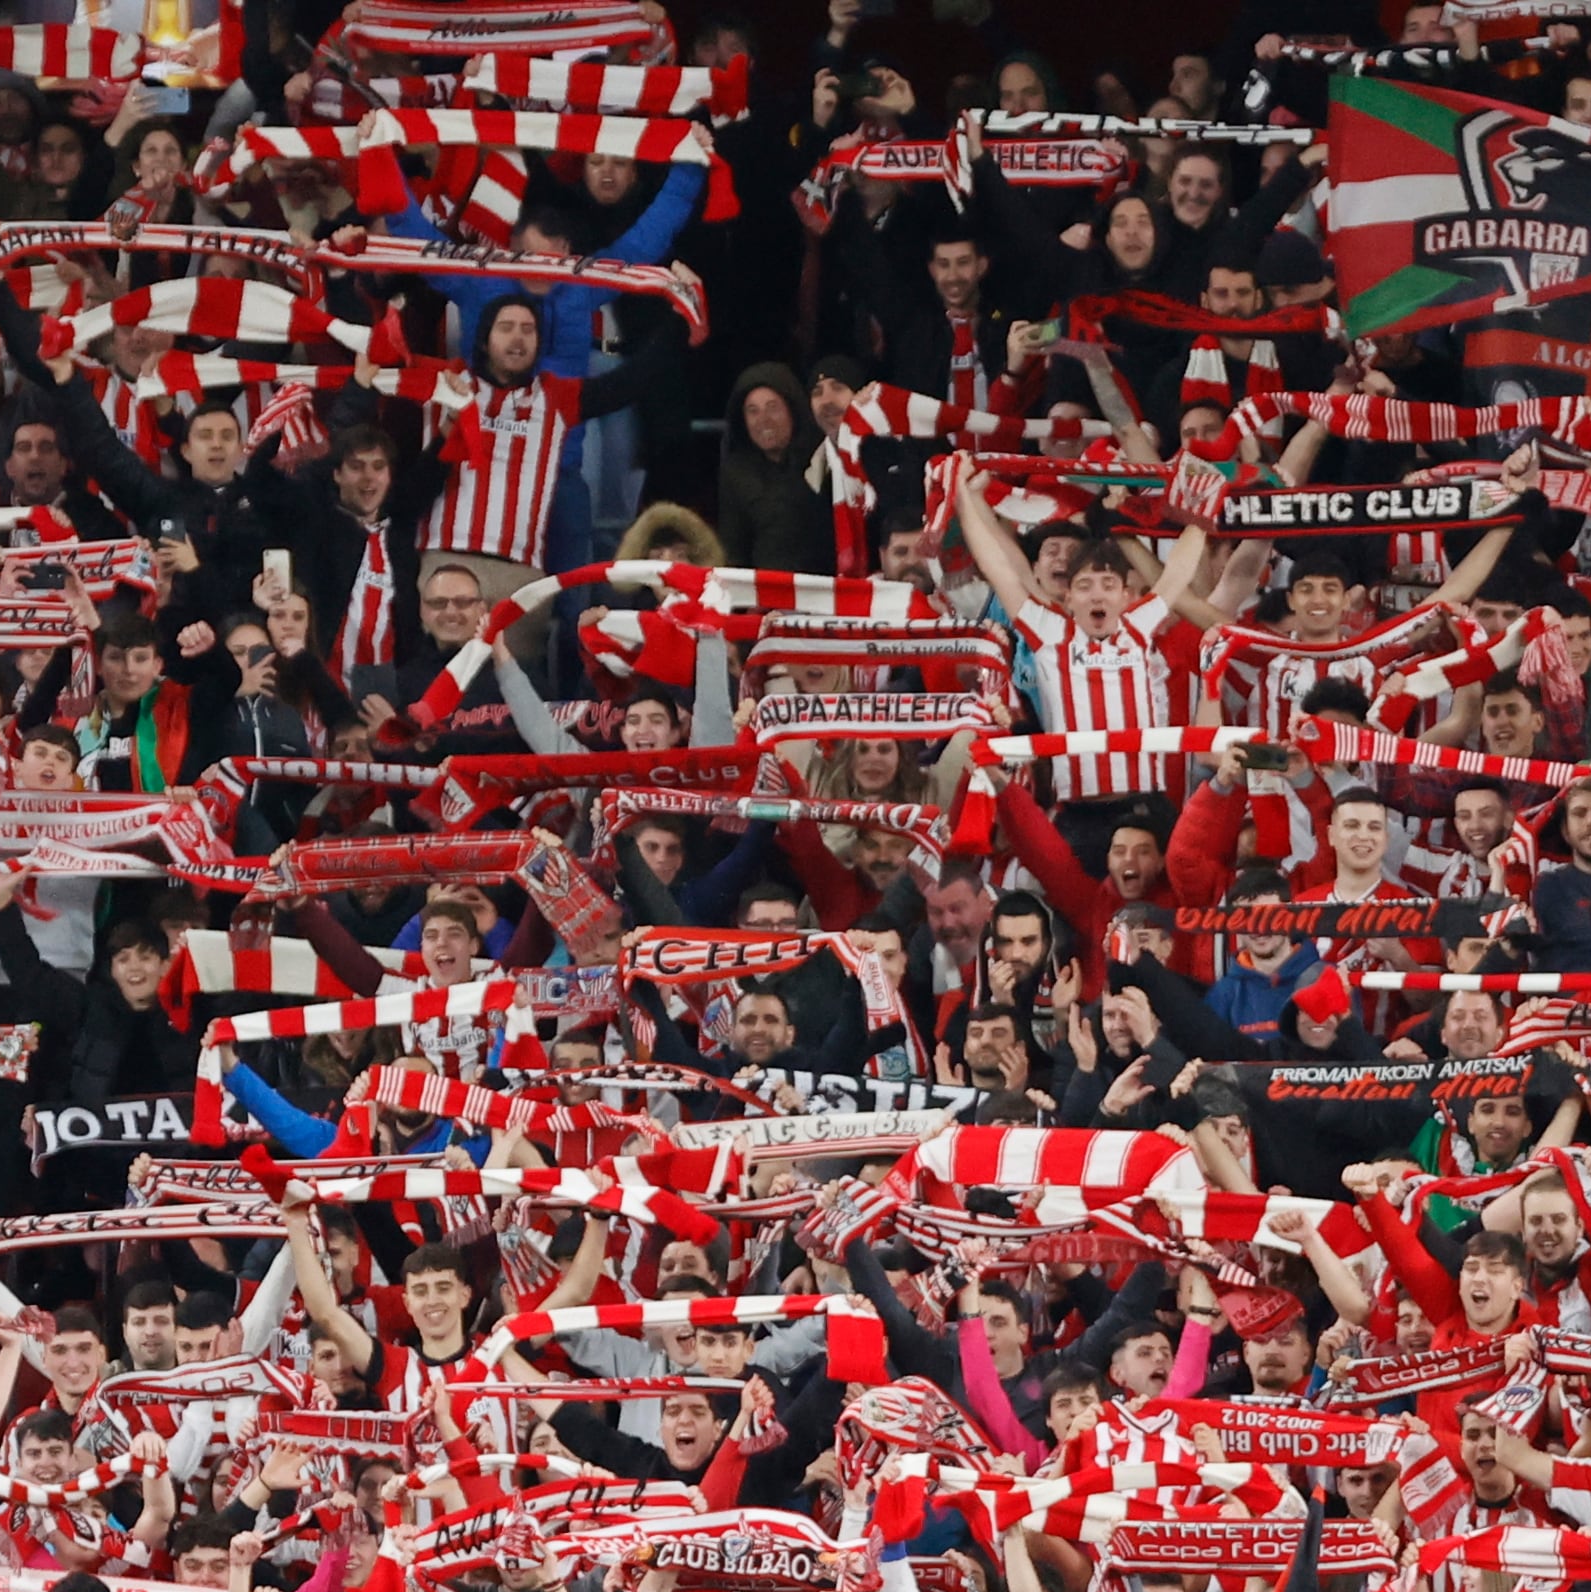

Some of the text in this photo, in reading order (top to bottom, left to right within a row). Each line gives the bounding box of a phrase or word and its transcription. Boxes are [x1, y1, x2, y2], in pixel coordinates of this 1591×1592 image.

[1424, 218, 1589, 256] GABARRA
[1363, 489, 1461, 520] CLUB
[1072, 646, 1143, 668] Kutxabank
[757, 693, 975, 726] AUPA ATHLETIC
[647, 762, 740, 785] CLUB
[1271, 1056, 1531, 1085] ERROMANTIKOEN AMETSAK
[35, 1097, 191, 1152] JO TA
[1381, 1356, 1461, 1385] copa
[1220, 1409, 1324, 1432] 2002-2012
[1258, 1431, 1319, 1457] Club
[566, 1482, 646, 1516] Club
[1133, 1520, 1303, 1540] ATHLETIC
[655, 1543, 811, 1581] CLUB BILBAO
[1137, 1542, 1221, 1559] copa
[1319, 1540, 1383, 1557] kopa
